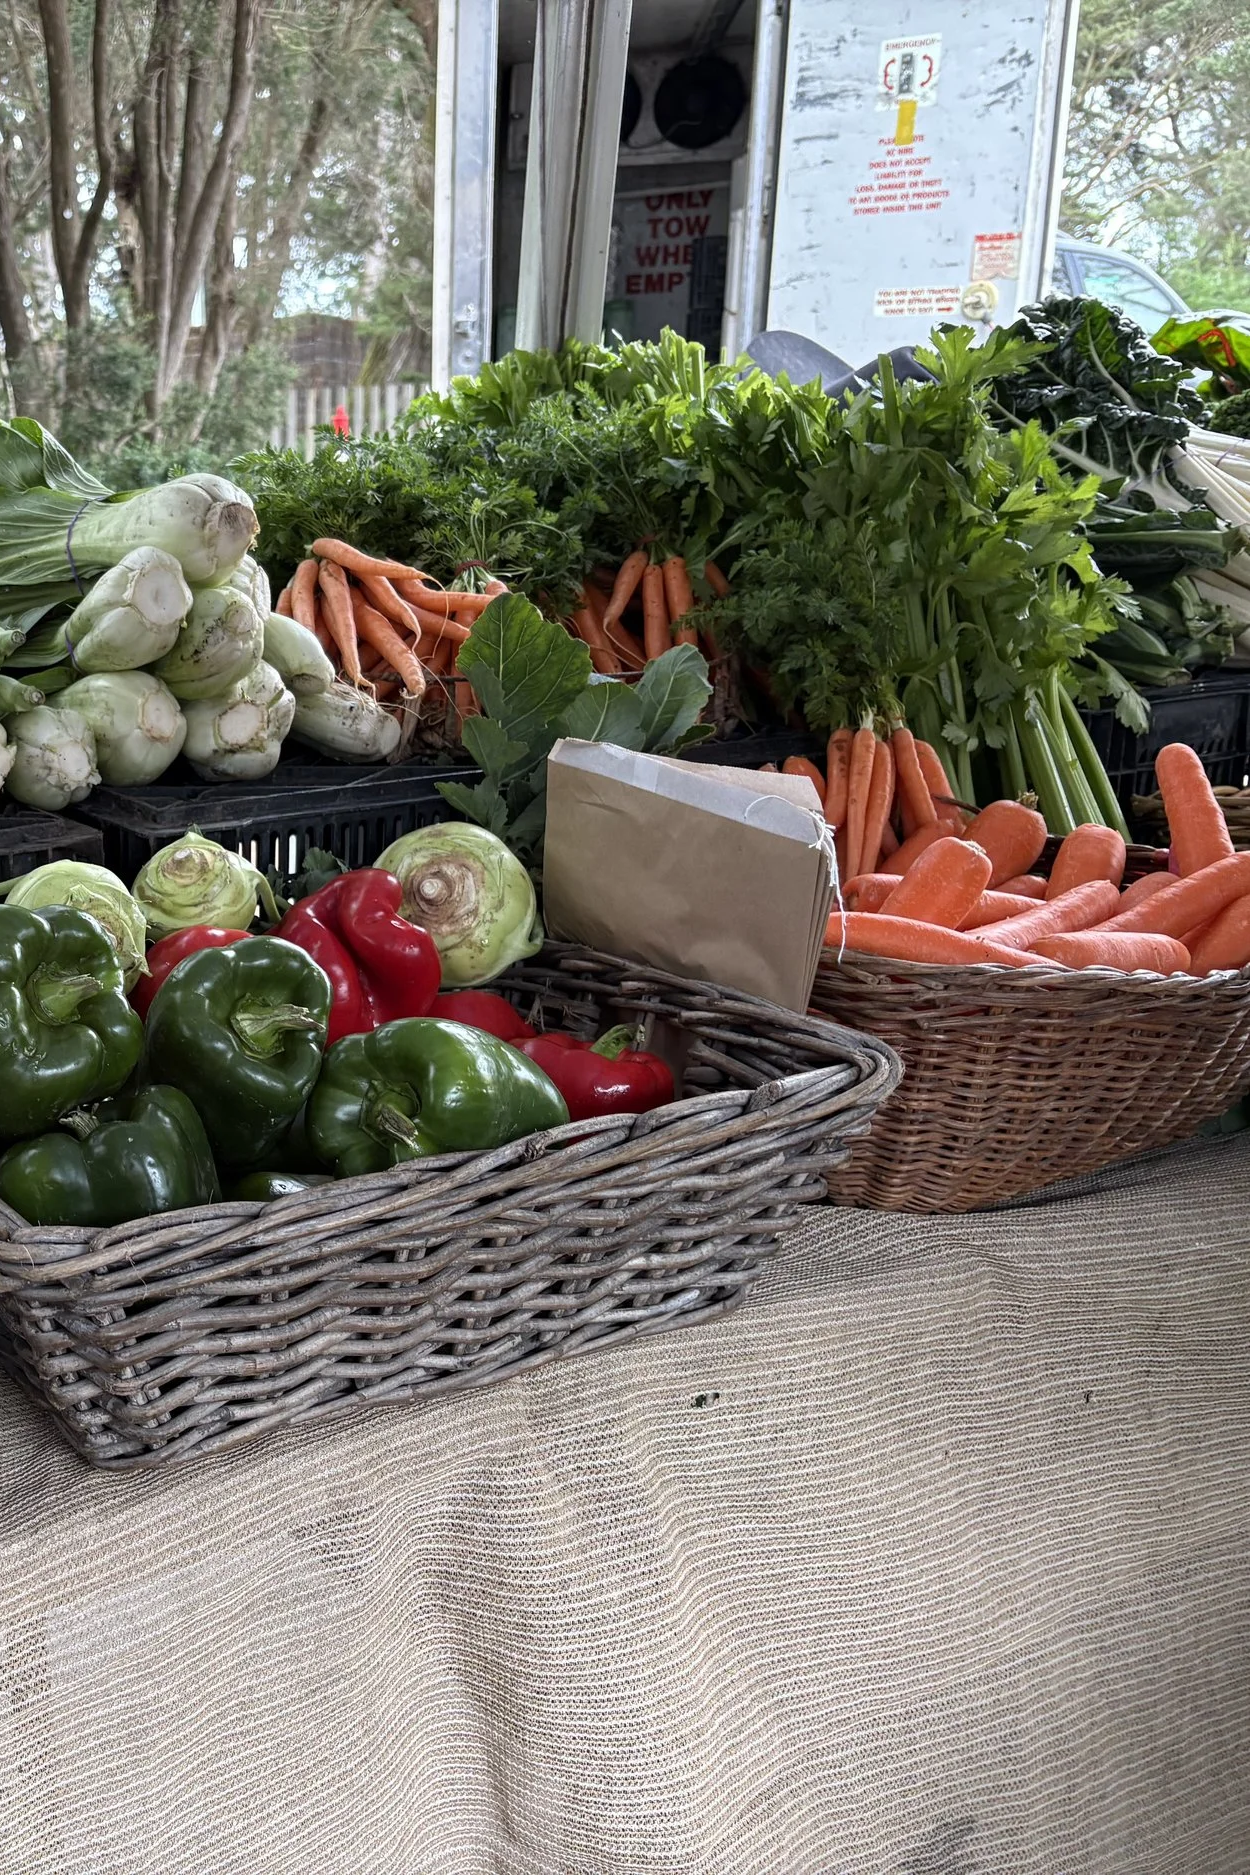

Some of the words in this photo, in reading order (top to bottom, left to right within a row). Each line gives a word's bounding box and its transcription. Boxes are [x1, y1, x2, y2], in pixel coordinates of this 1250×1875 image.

[905, 157, 931, 166] ACCEPT
[645, 189, 713, 211] ONLY
[913, 190, 949, 199] PRODUCTS
[647, 215, 710, 239] TOW
[635, 244, 694, 267] WHE
